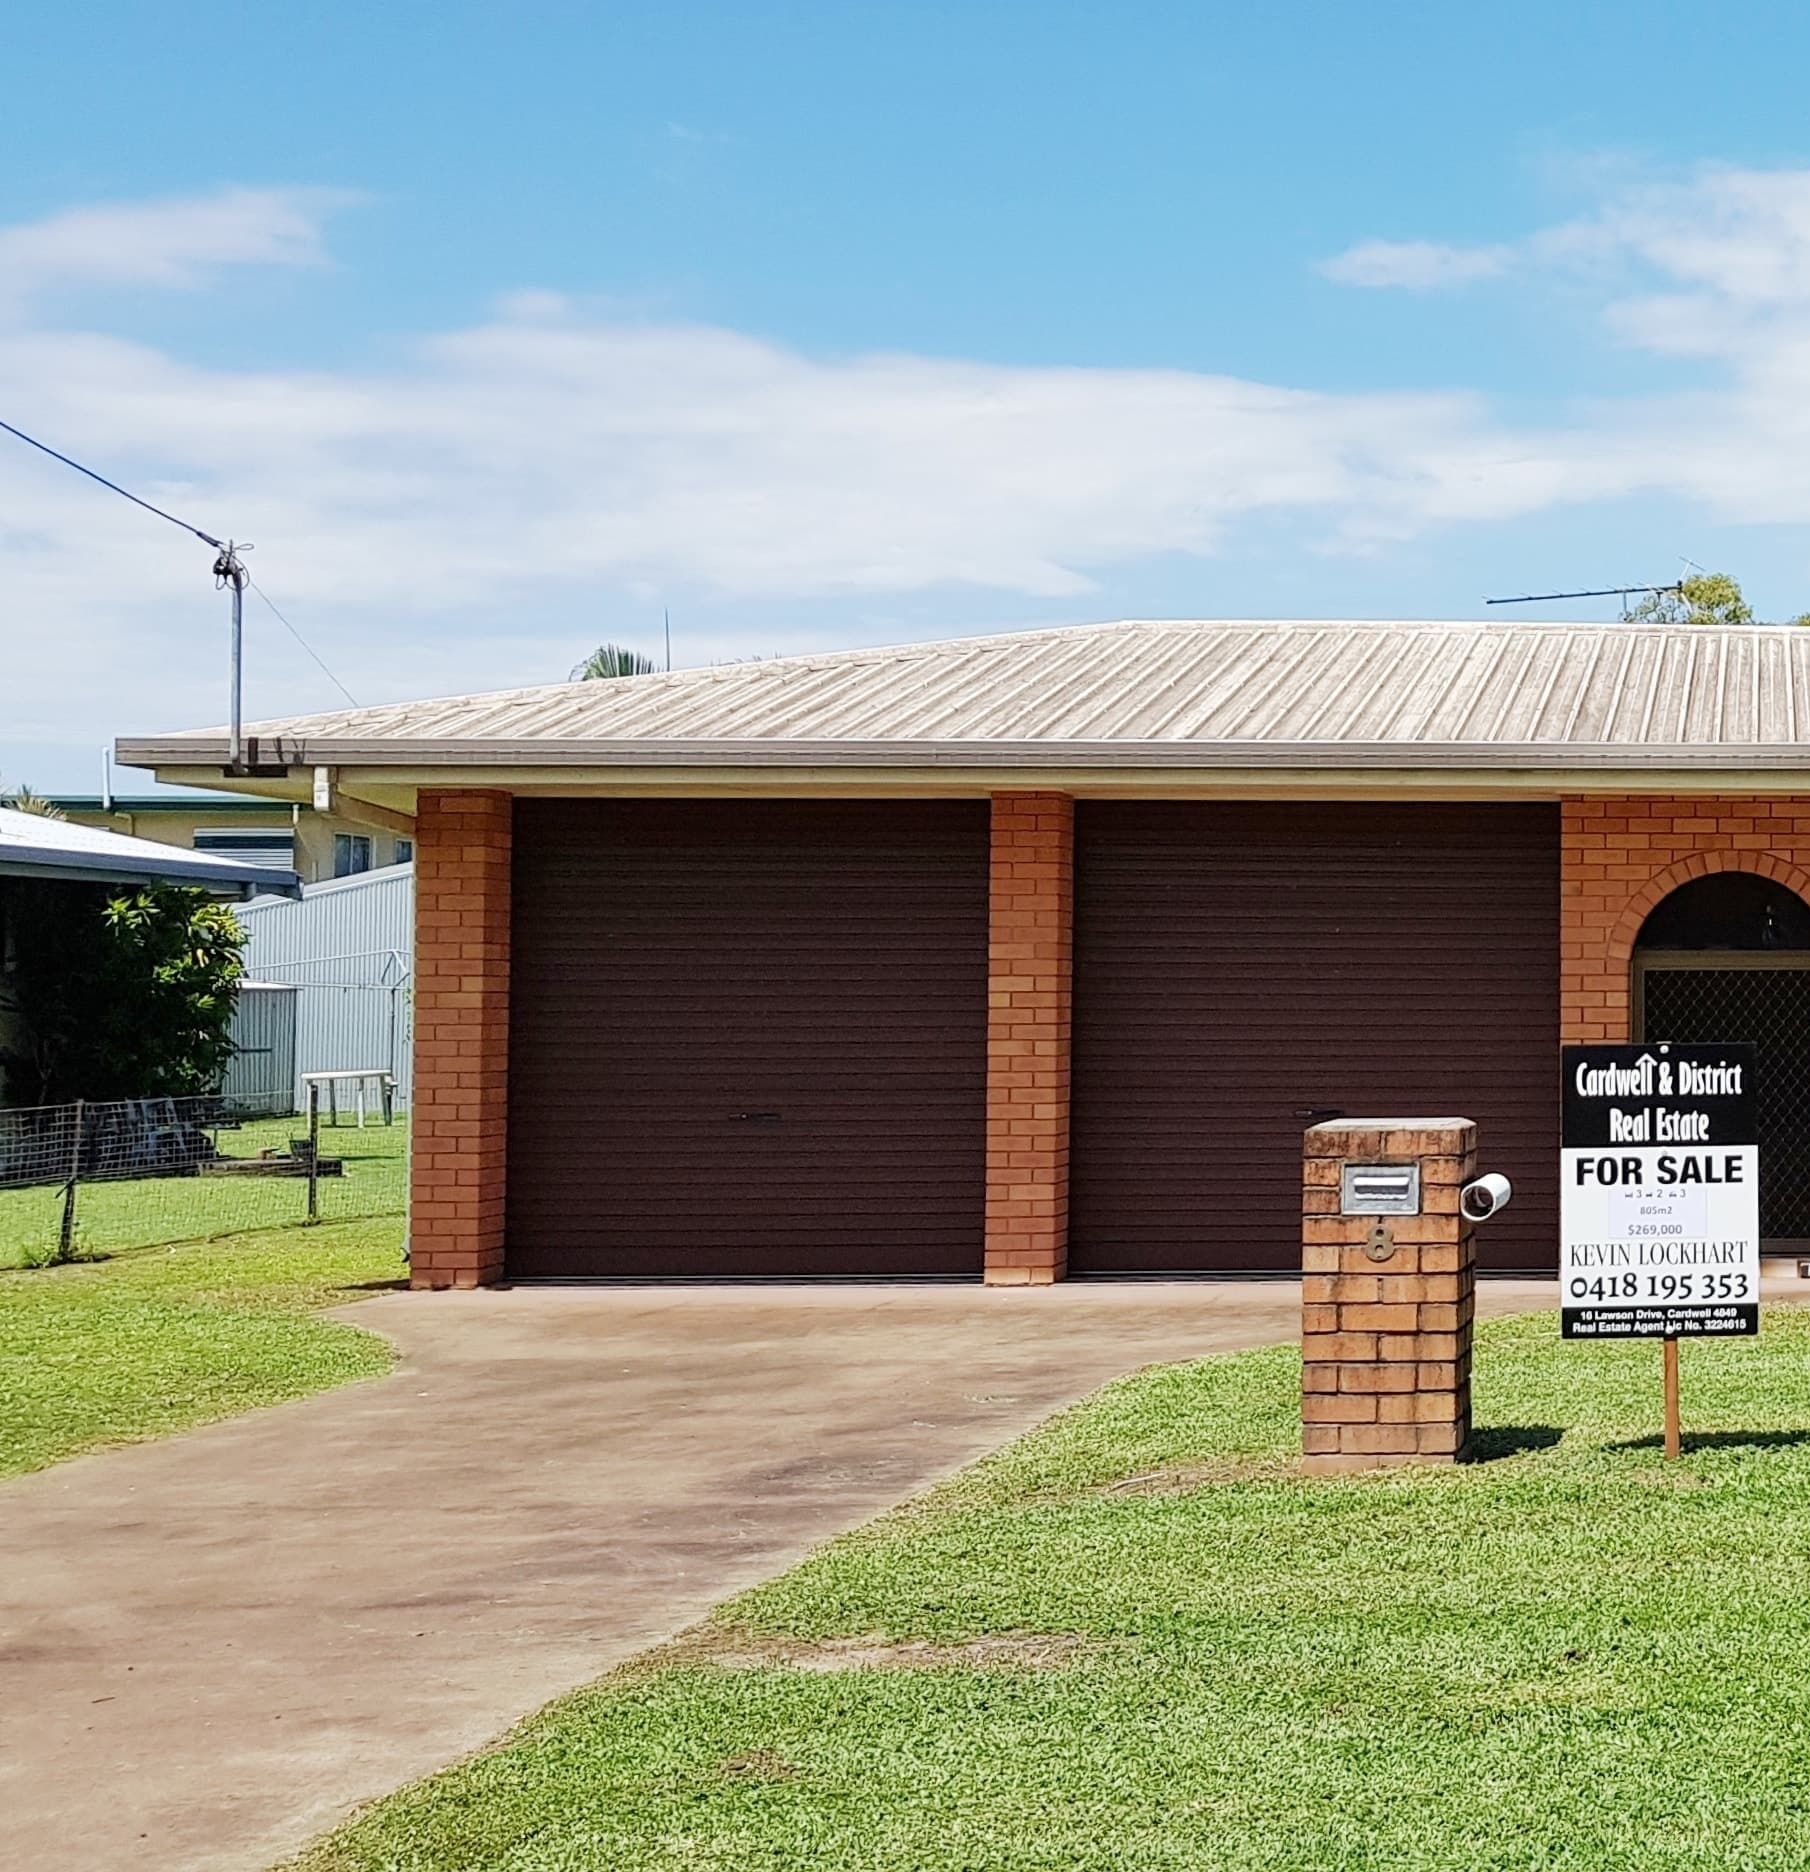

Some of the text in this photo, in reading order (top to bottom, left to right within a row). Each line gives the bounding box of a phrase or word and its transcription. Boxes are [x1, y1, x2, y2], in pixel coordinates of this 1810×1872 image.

[1576, 1060, 1742, 1096] Cardwell & District
[1610, 1107, 1710, 1142] Real Estate
[1576, 1155, 1743, 1185] FOR SALE
[1657, 1188, 1663, 1198] 2
[1680, 1188, 1686, 1198] 3
[1366, 1224, 1394, 1262] 8
[1628, 1224, 1683, 1236] $269,000
[1570, 1241, 1748, 1267] KEVIN LOCKHART
[1570, 1272, 1748, 1301] 0418 195 353
[1572, 1322, 1596, 1333] Real
[1600, 1322, 1631, 1332] Estate
[1633, 1321, 1664, 1334] Agent
[1684, 1320, 1702, 1331] No.
[1595, 1310, 1633, 1320] Lawson
[1636, 1309, 1665, 1320] Drive,
[1667, 1308, 1711, 1319] Cardwell
[1713, 1307, 1737, 1318] 4849
